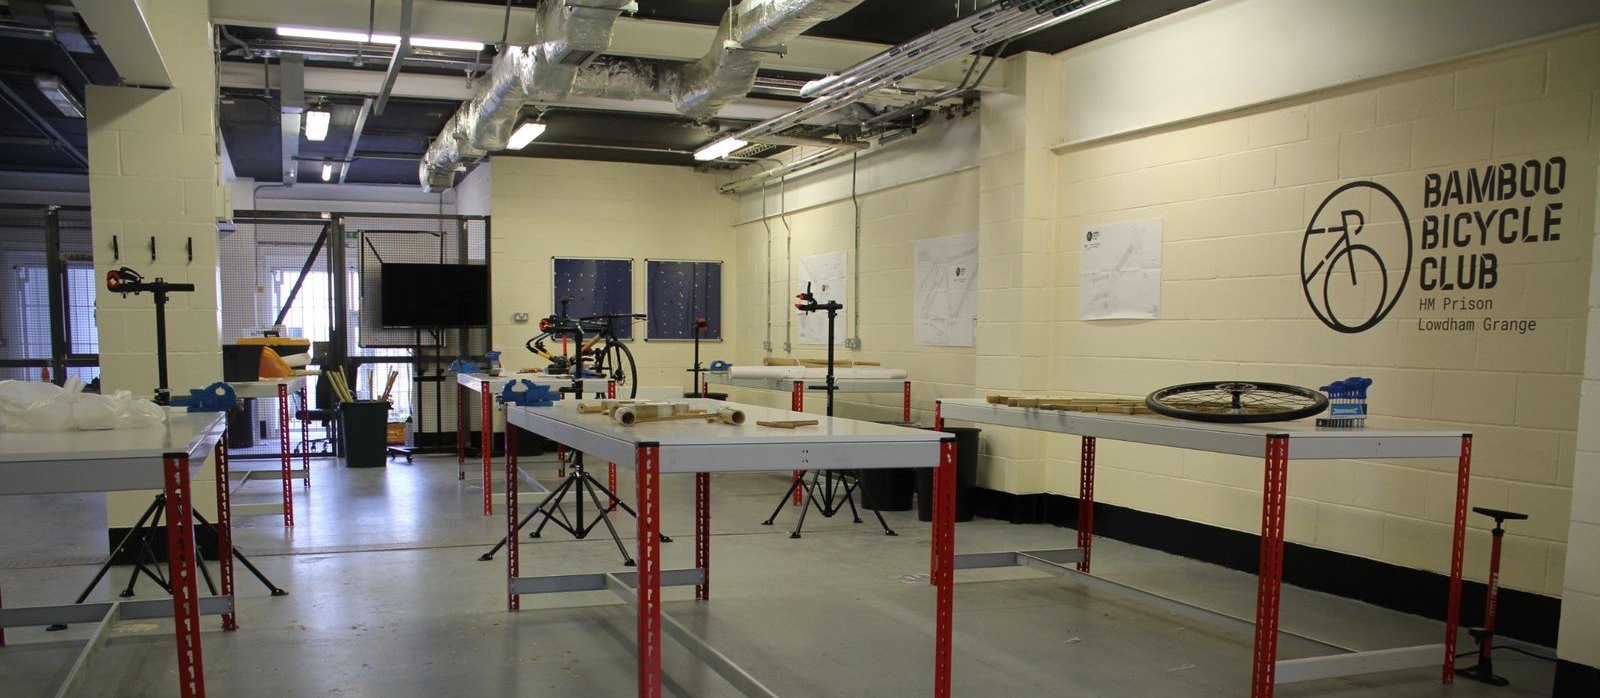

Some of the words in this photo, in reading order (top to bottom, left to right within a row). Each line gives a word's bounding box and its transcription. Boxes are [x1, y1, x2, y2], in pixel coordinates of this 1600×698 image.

[1424, 156, 1566, 208] BAMBOO
[1421, 203, 1563, 250] BICYCLE
[1420, 253, 1498, 291] CLUB
[1419, 298, 1435, 310] HM
[1443, 297, 1493, 310] Prison
[1418, 317, 1475, 331] Lowdham
[1483, 317, 1537, 334] Grange
